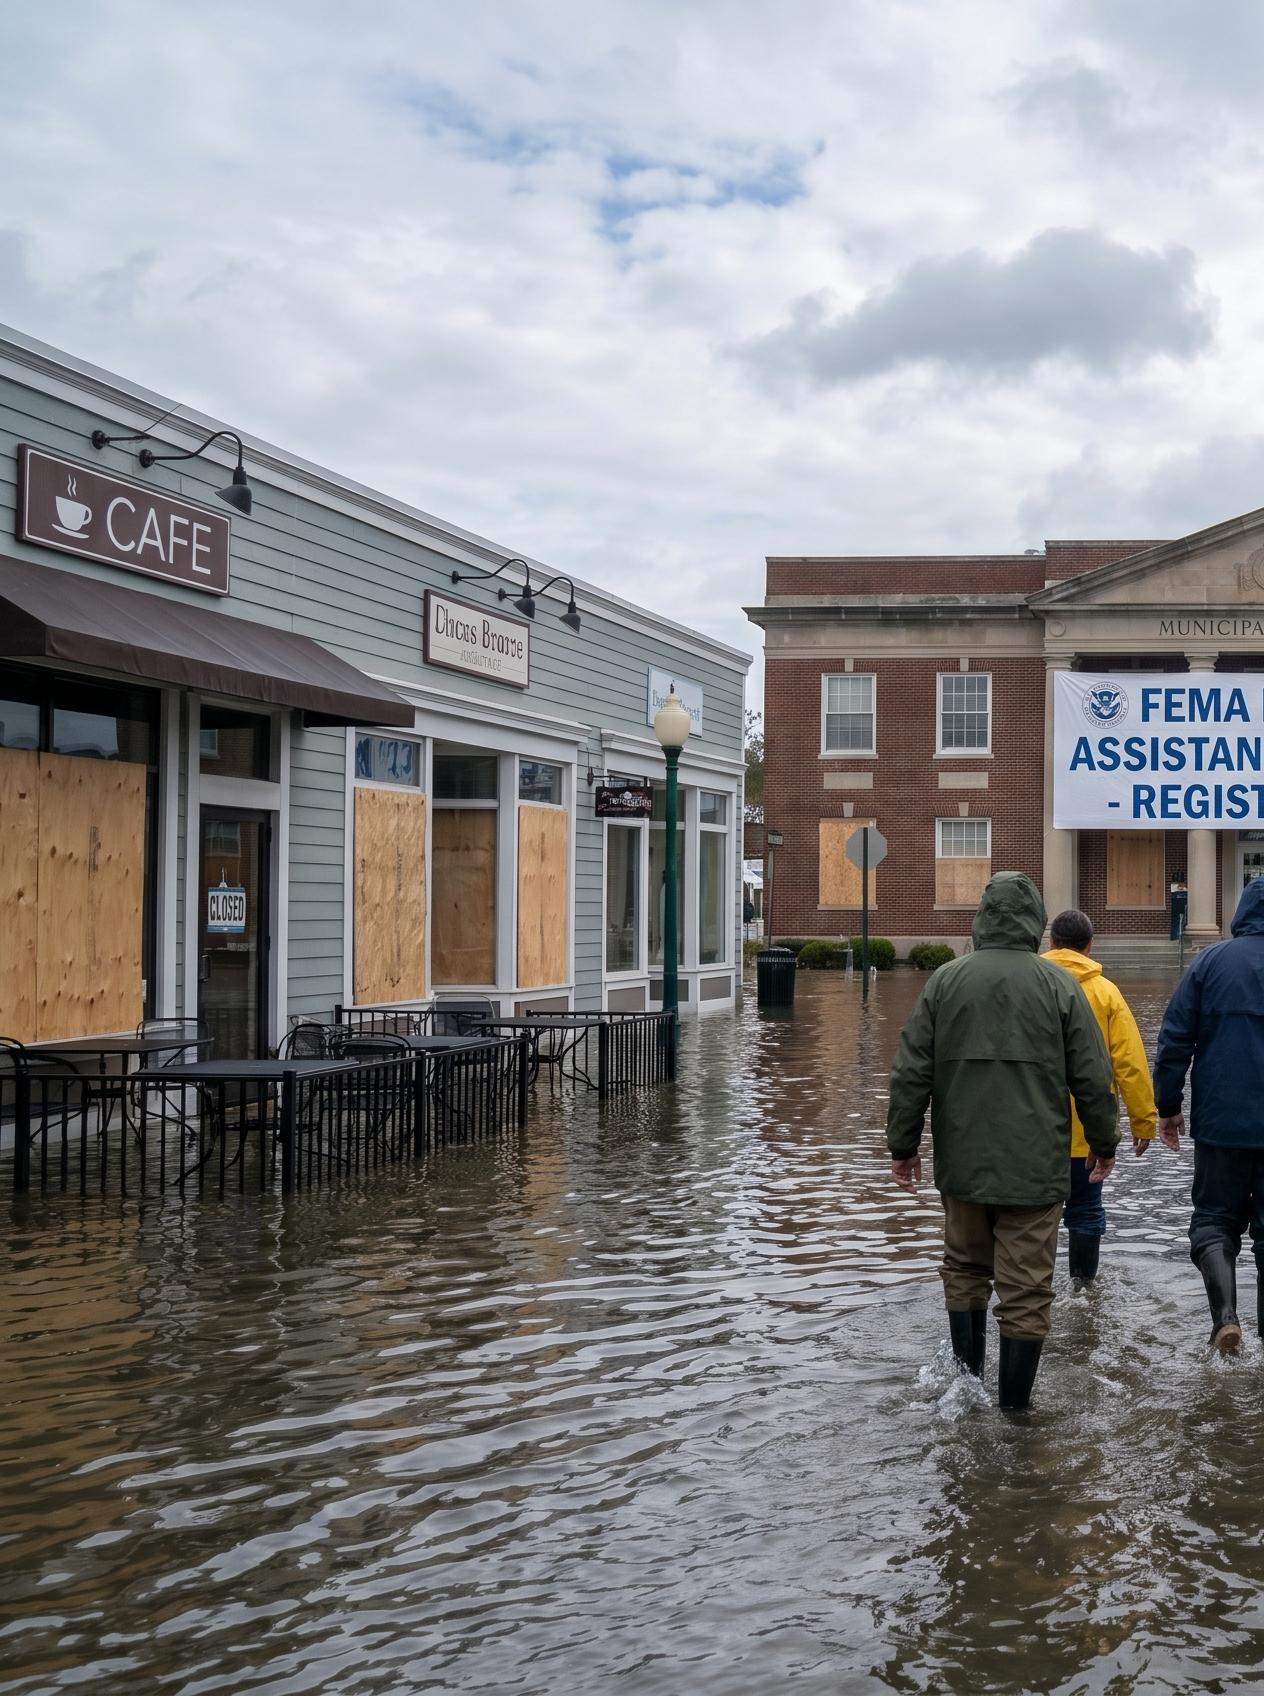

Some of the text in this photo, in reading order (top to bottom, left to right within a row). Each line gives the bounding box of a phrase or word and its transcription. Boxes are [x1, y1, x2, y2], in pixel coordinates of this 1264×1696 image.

[106, 496, 212, 575] CAFE
[1141, 687, 1251, 723] FEMA
[210, 895, 244, 922] CLOSED
